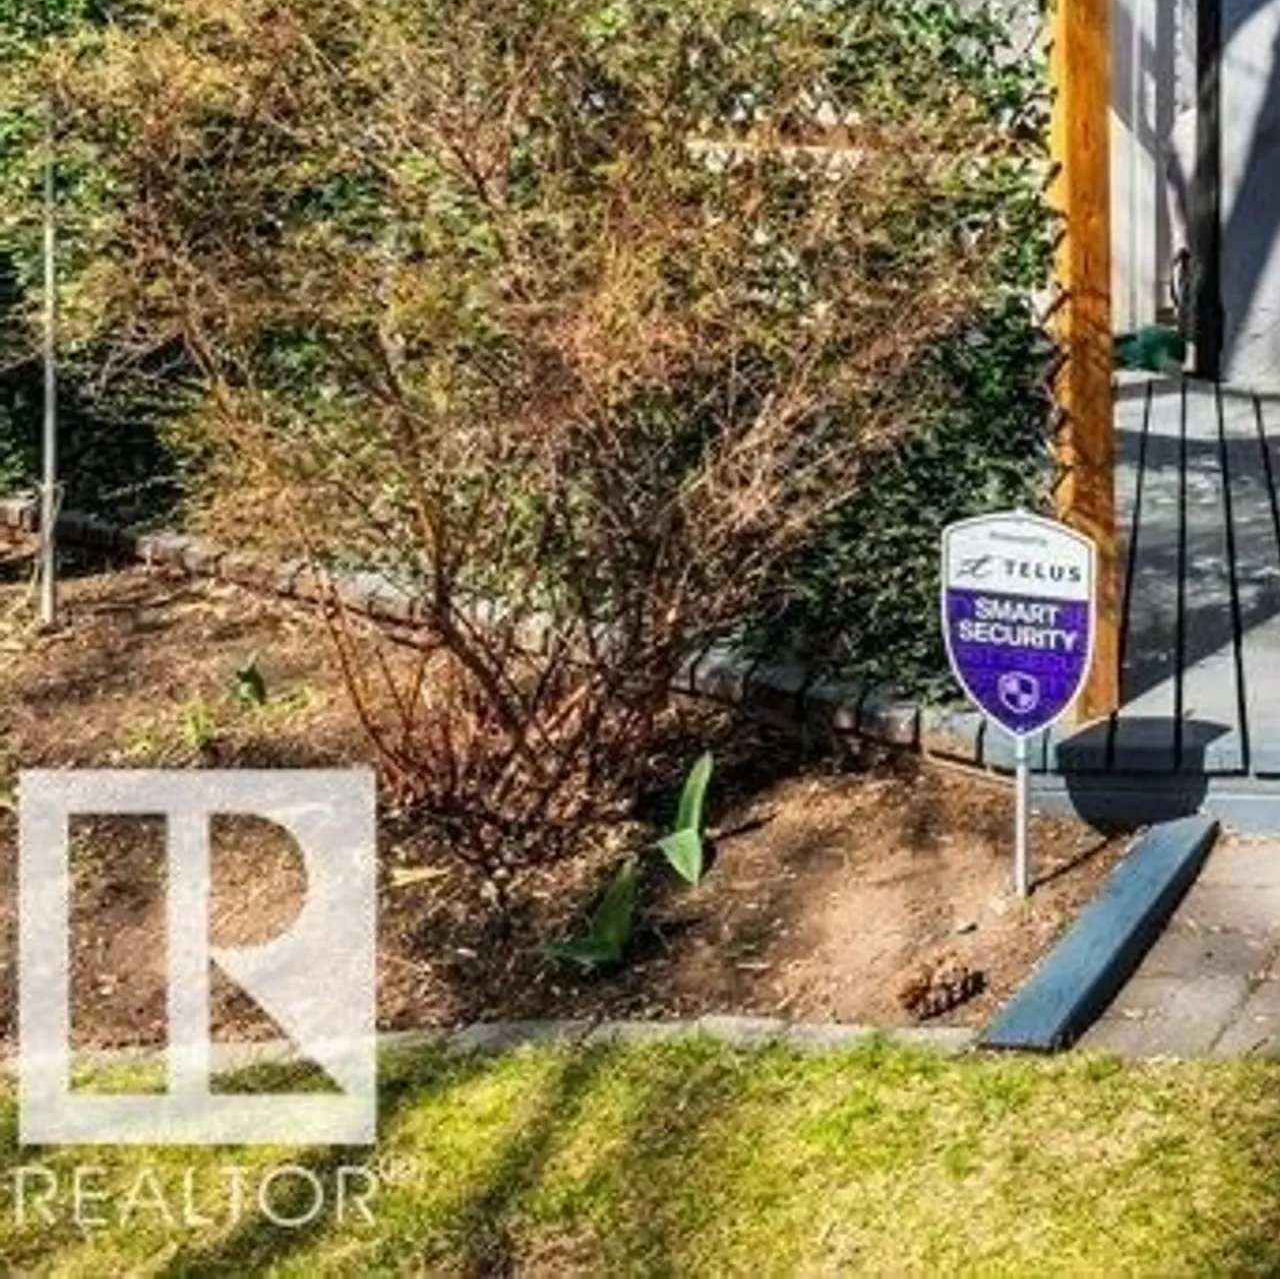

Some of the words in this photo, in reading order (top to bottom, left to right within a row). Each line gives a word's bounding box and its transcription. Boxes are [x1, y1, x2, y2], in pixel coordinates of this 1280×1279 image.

[1005, 559, 1081, 582] TELUS
[974, 596, 1059, 627] SMART
[959, 618, 1077, 651] SECURITY
